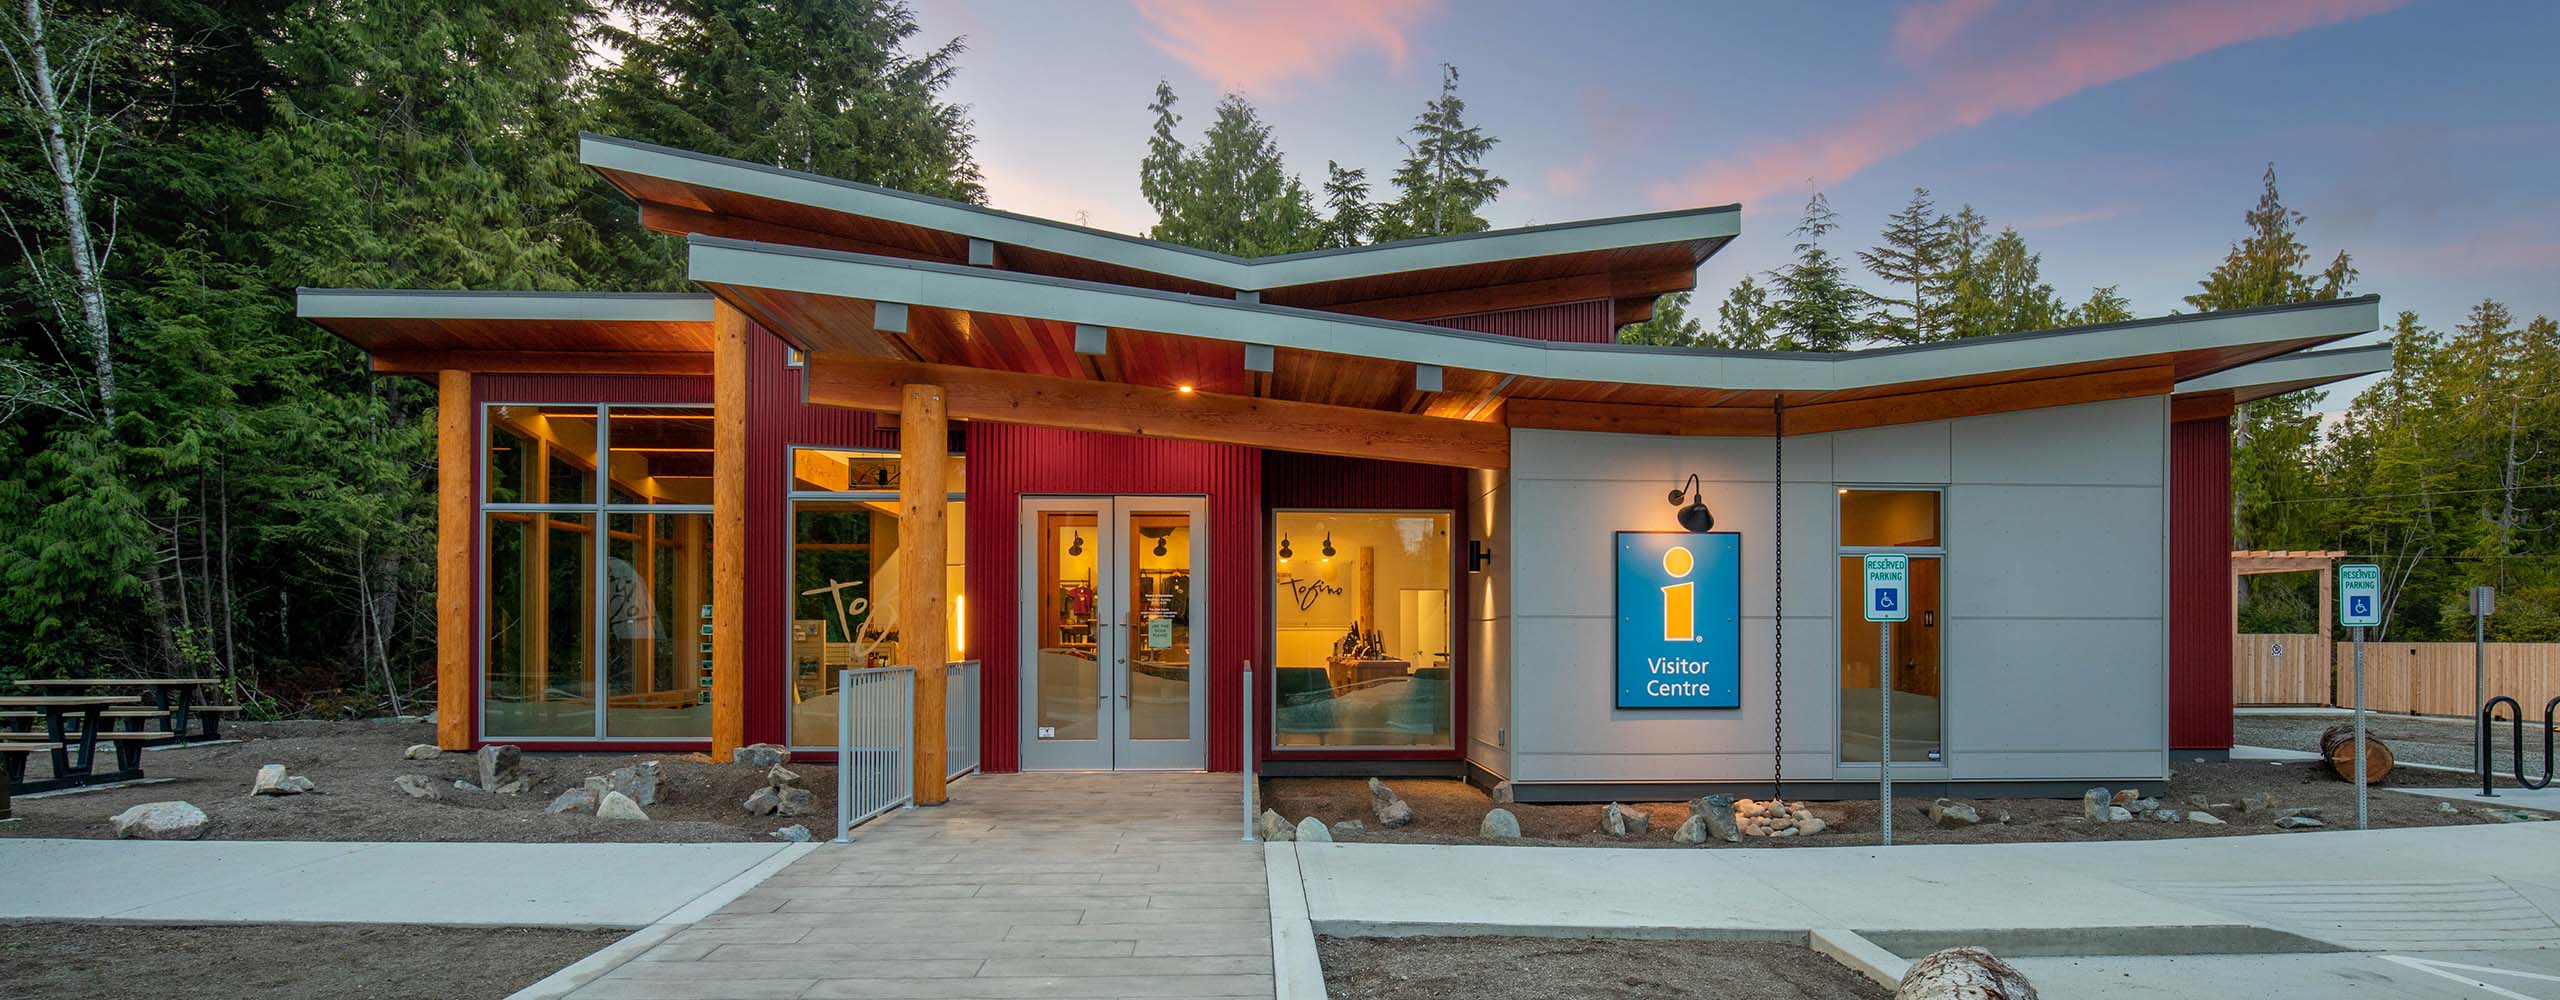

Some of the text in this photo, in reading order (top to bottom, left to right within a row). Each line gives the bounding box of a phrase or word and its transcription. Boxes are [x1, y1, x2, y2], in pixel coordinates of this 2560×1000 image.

[1867, 561, 1904, 569] RESERVED
[1870, 572, 1902, 580] PARKING
[2343, 571, 2377, 579] RESERVED
[2345, 581, 2375, 589] PARKING
[1280, 578, 1342, 611] Tofino
[1647, 657, 1709, 674] Visitor
[1646, 680, 1710, 696] Centre
